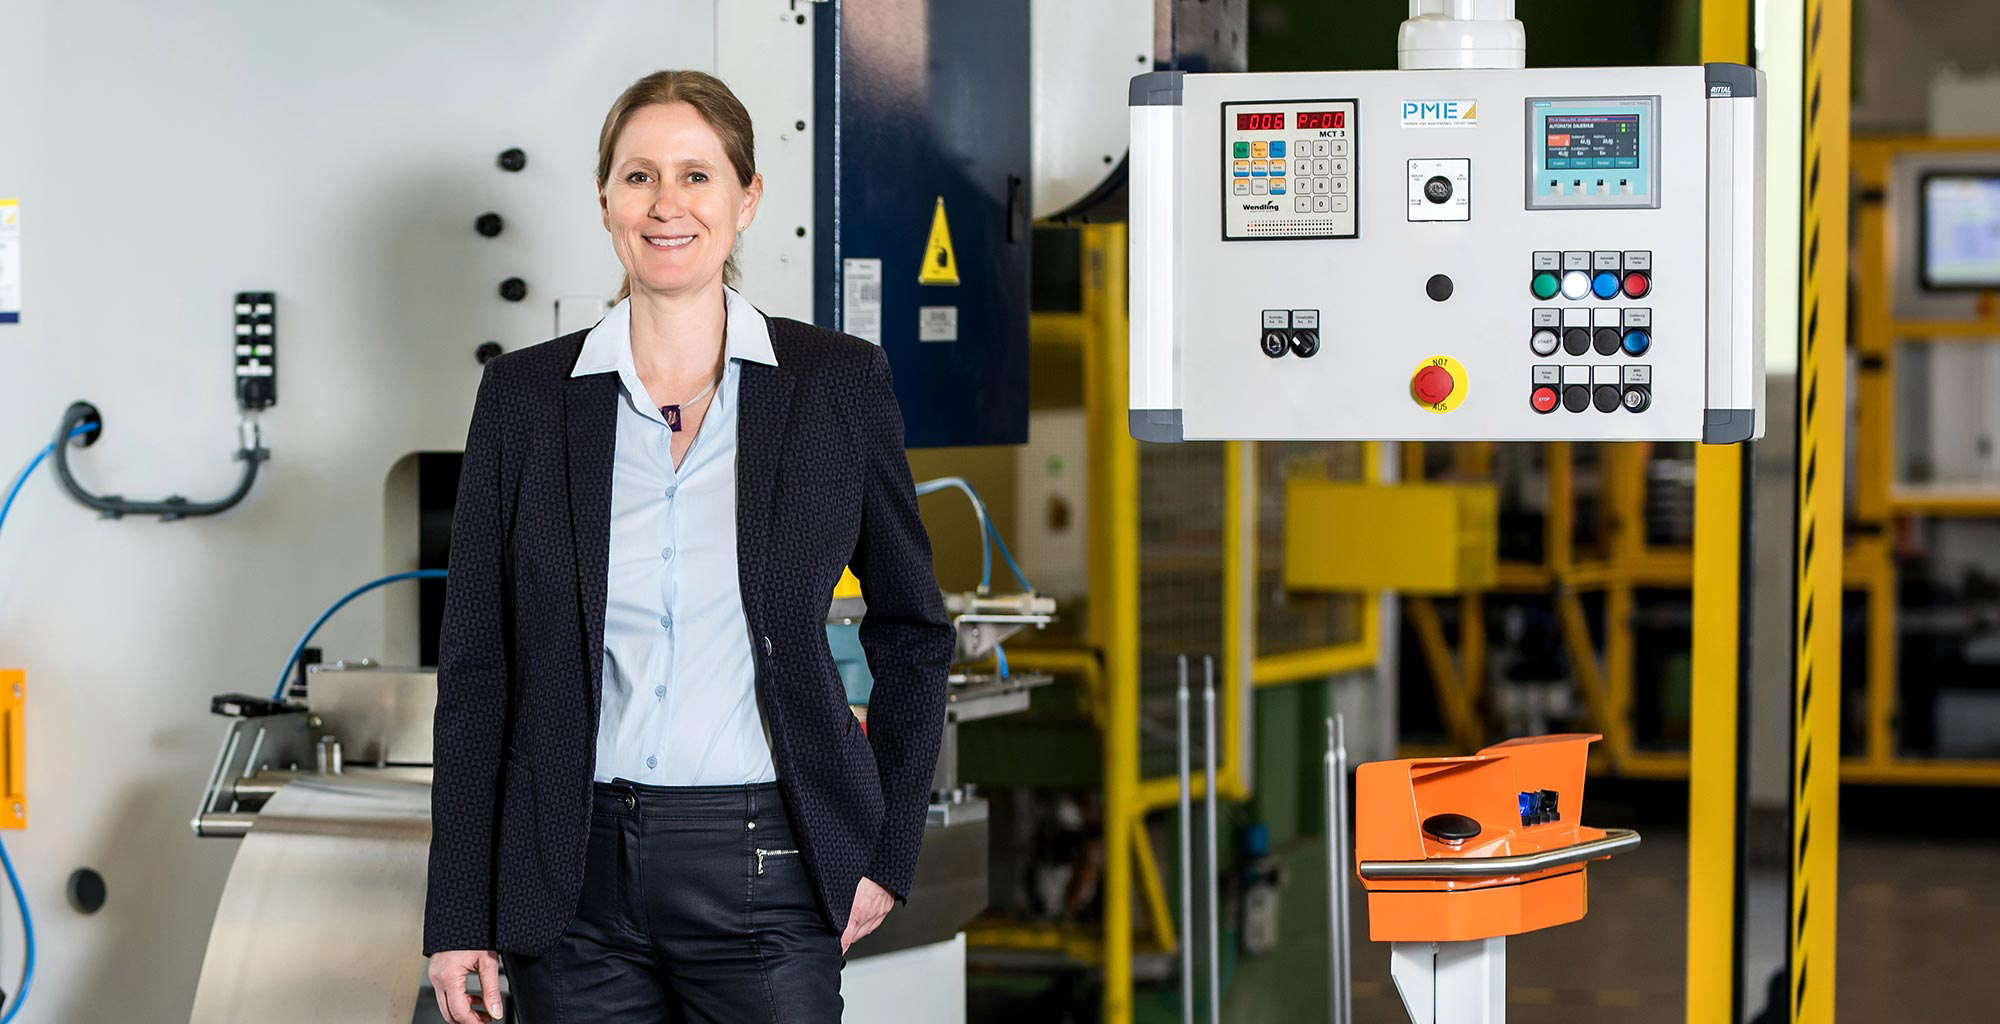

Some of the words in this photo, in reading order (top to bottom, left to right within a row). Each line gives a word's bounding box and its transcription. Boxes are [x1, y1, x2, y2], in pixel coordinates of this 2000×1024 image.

[1403, 102, 1457, 119] PME
[1250, 114, 1283, 130] 006
[1298, 113, 1344, 128] Pr00
[1243, 201, 1279, 211] Wendling
[1433, 358, 1448, 366] NOT
[1432, 403, 1447, 411] AUS
